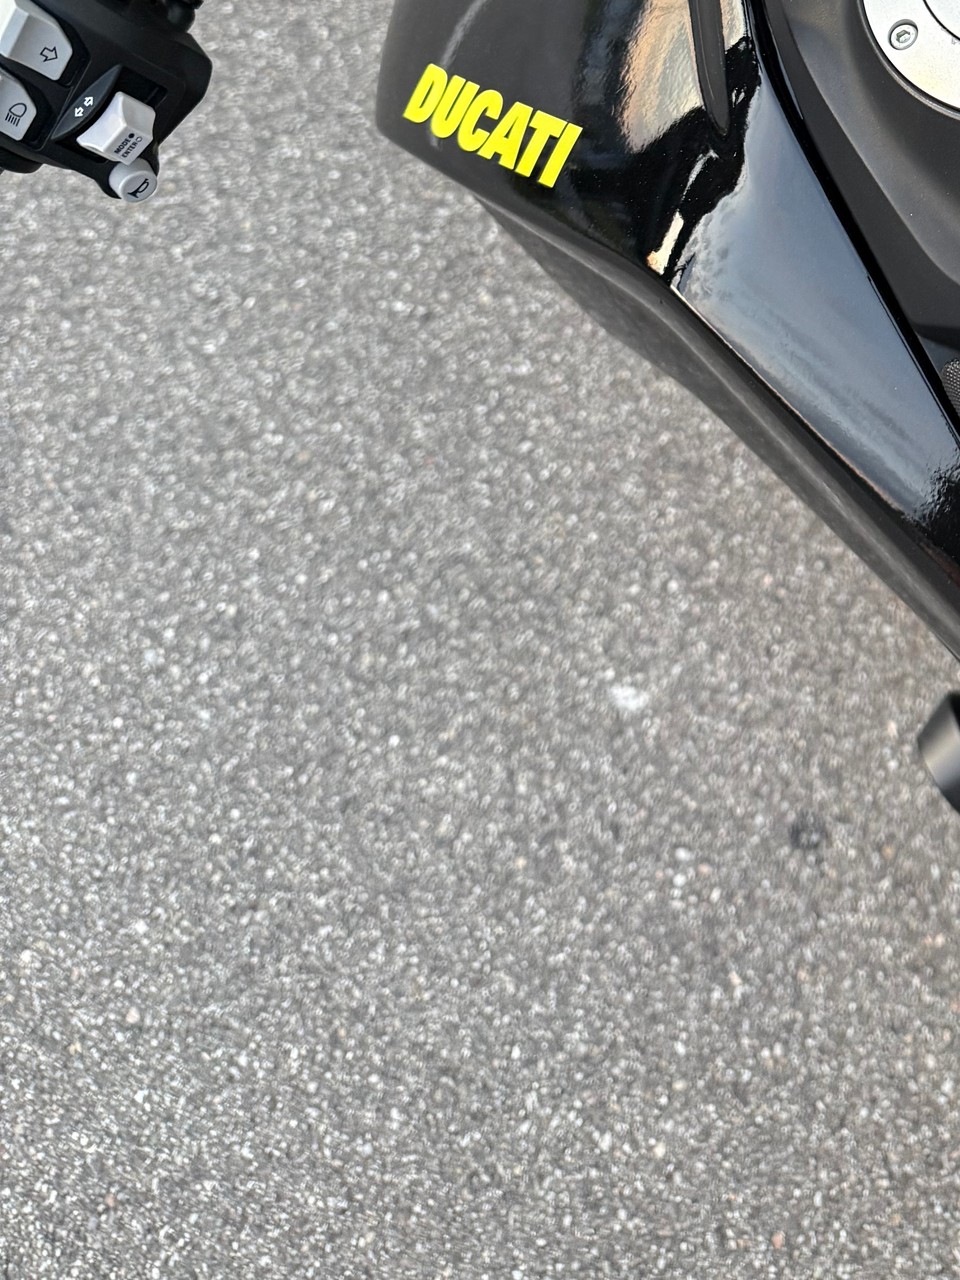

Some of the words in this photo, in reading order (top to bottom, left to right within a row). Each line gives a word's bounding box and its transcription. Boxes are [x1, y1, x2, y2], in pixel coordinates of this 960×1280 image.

[402, 63, 584, 188] DUCATI
[114, 138, 131, 154] MODE
[121, 141, 138, 158] ENTER
